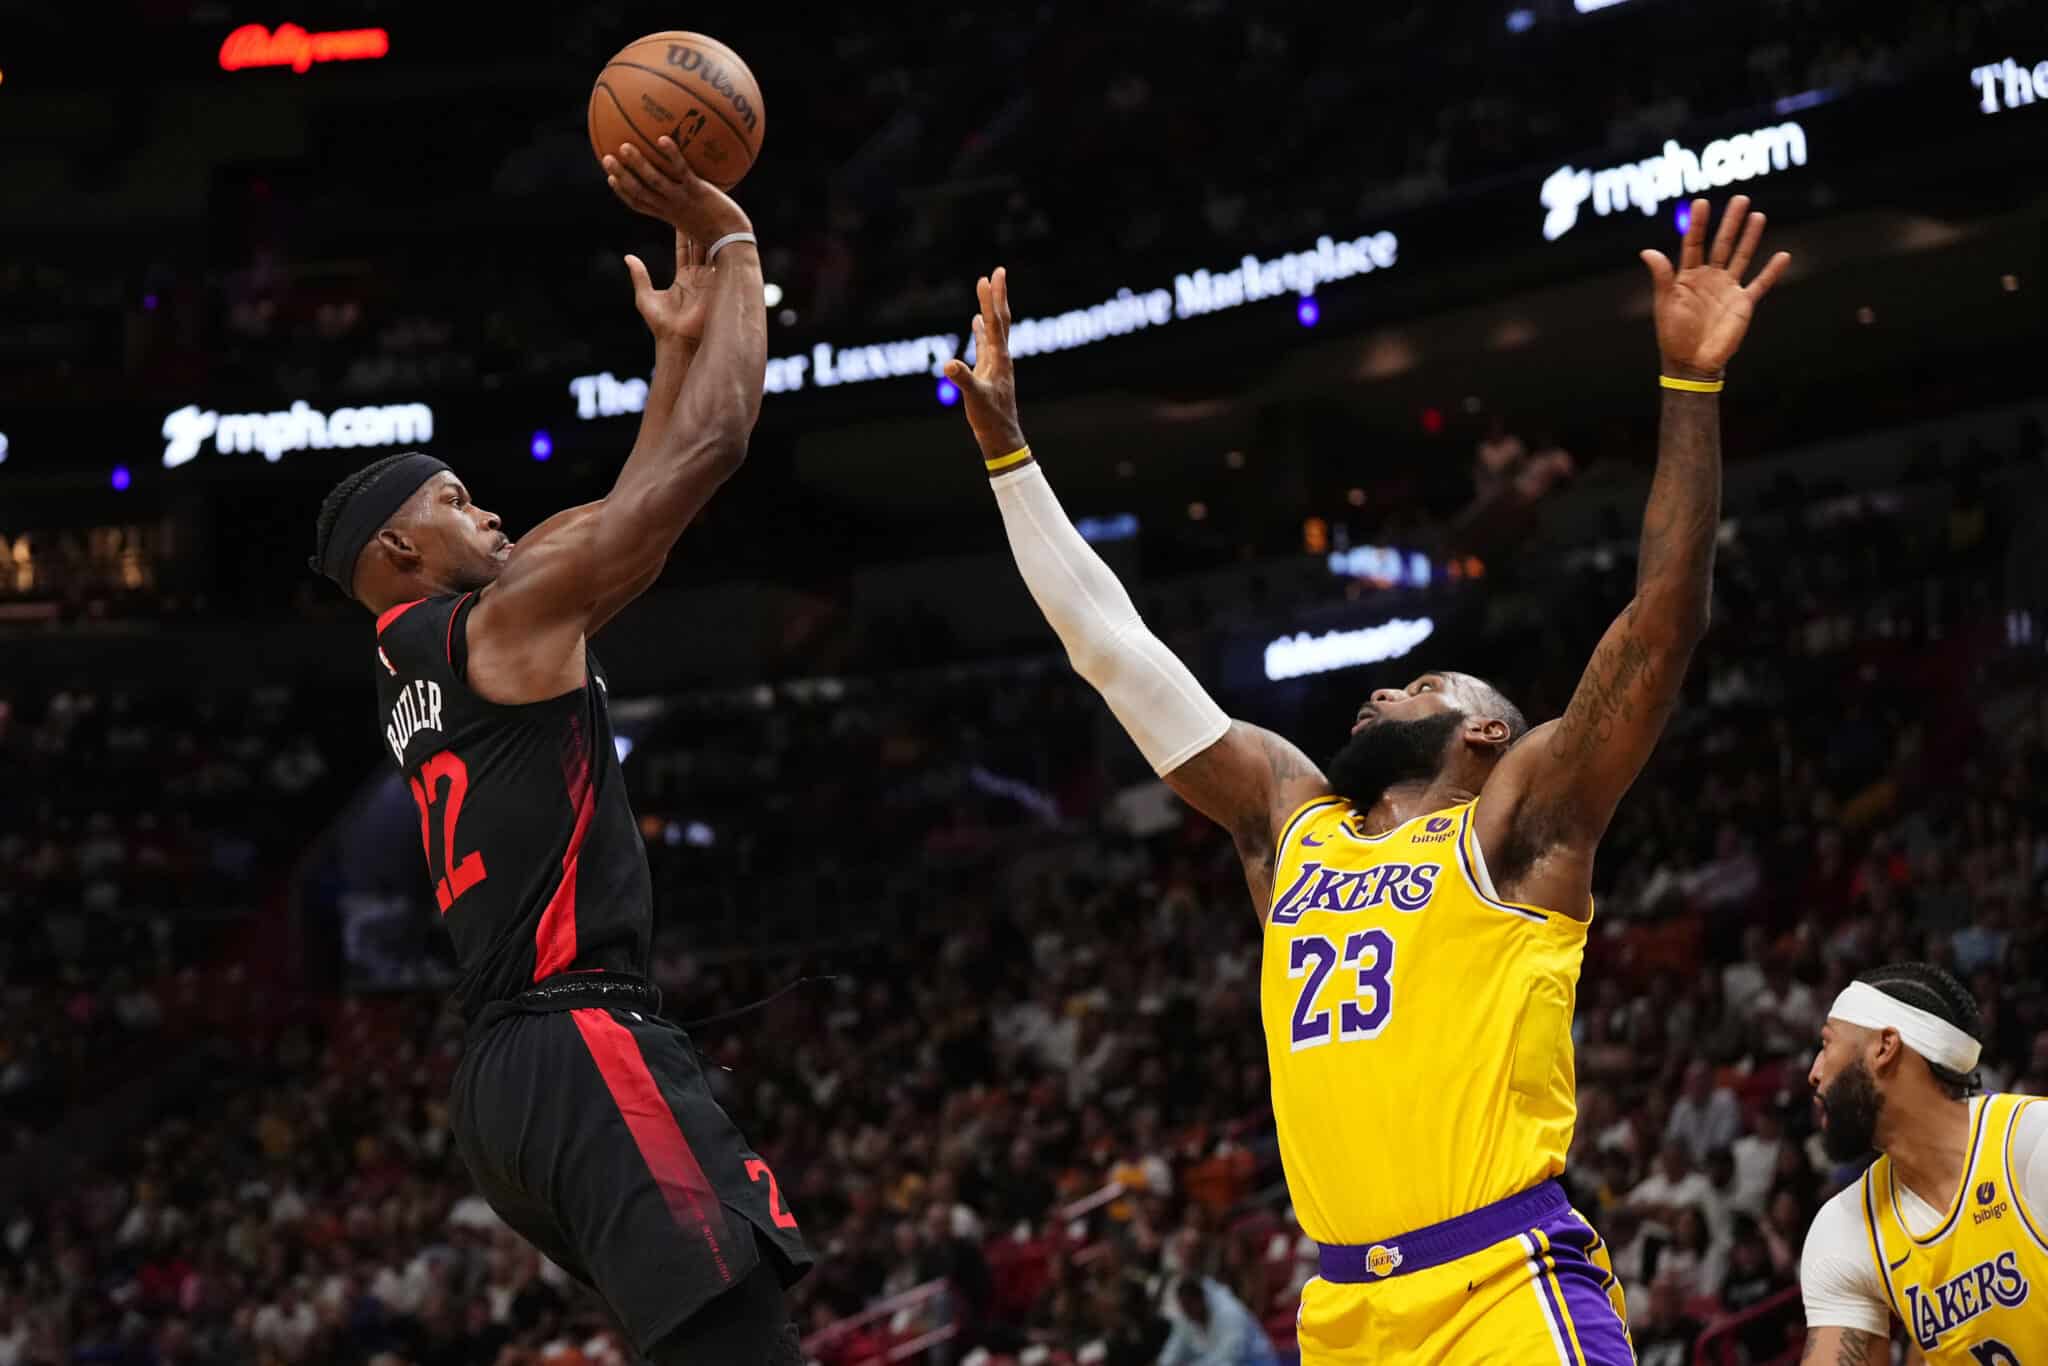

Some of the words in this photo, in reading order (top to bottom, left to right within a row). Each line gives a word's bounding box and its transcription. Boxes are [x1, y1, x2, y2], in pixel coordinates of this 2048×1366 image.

[667, 44, 756, 133] Wilson
[1592, 121, 1807, 216] mph.com
[570, 372, 648, 419] The
[813, 333, 959, 387] Luxury
[964, 285, 1171, 366] utomotive
[1174, 230, 1398, 319] Marketplace
[216, 400, 433, 462] mph.com
[387, 679, 443, 768] BUTLER
[1411, 830, 1456, 844] bibigo
[1271, 861, 1441, 926] LAKERS
[1288, 928, 1396, 1054] 23
[1973, 1201, 2008, 1225] bibigo
[1366, 1249, 1403, 1273] LAKERS
[1904, 1250, 2030, 1352] LAKERS
